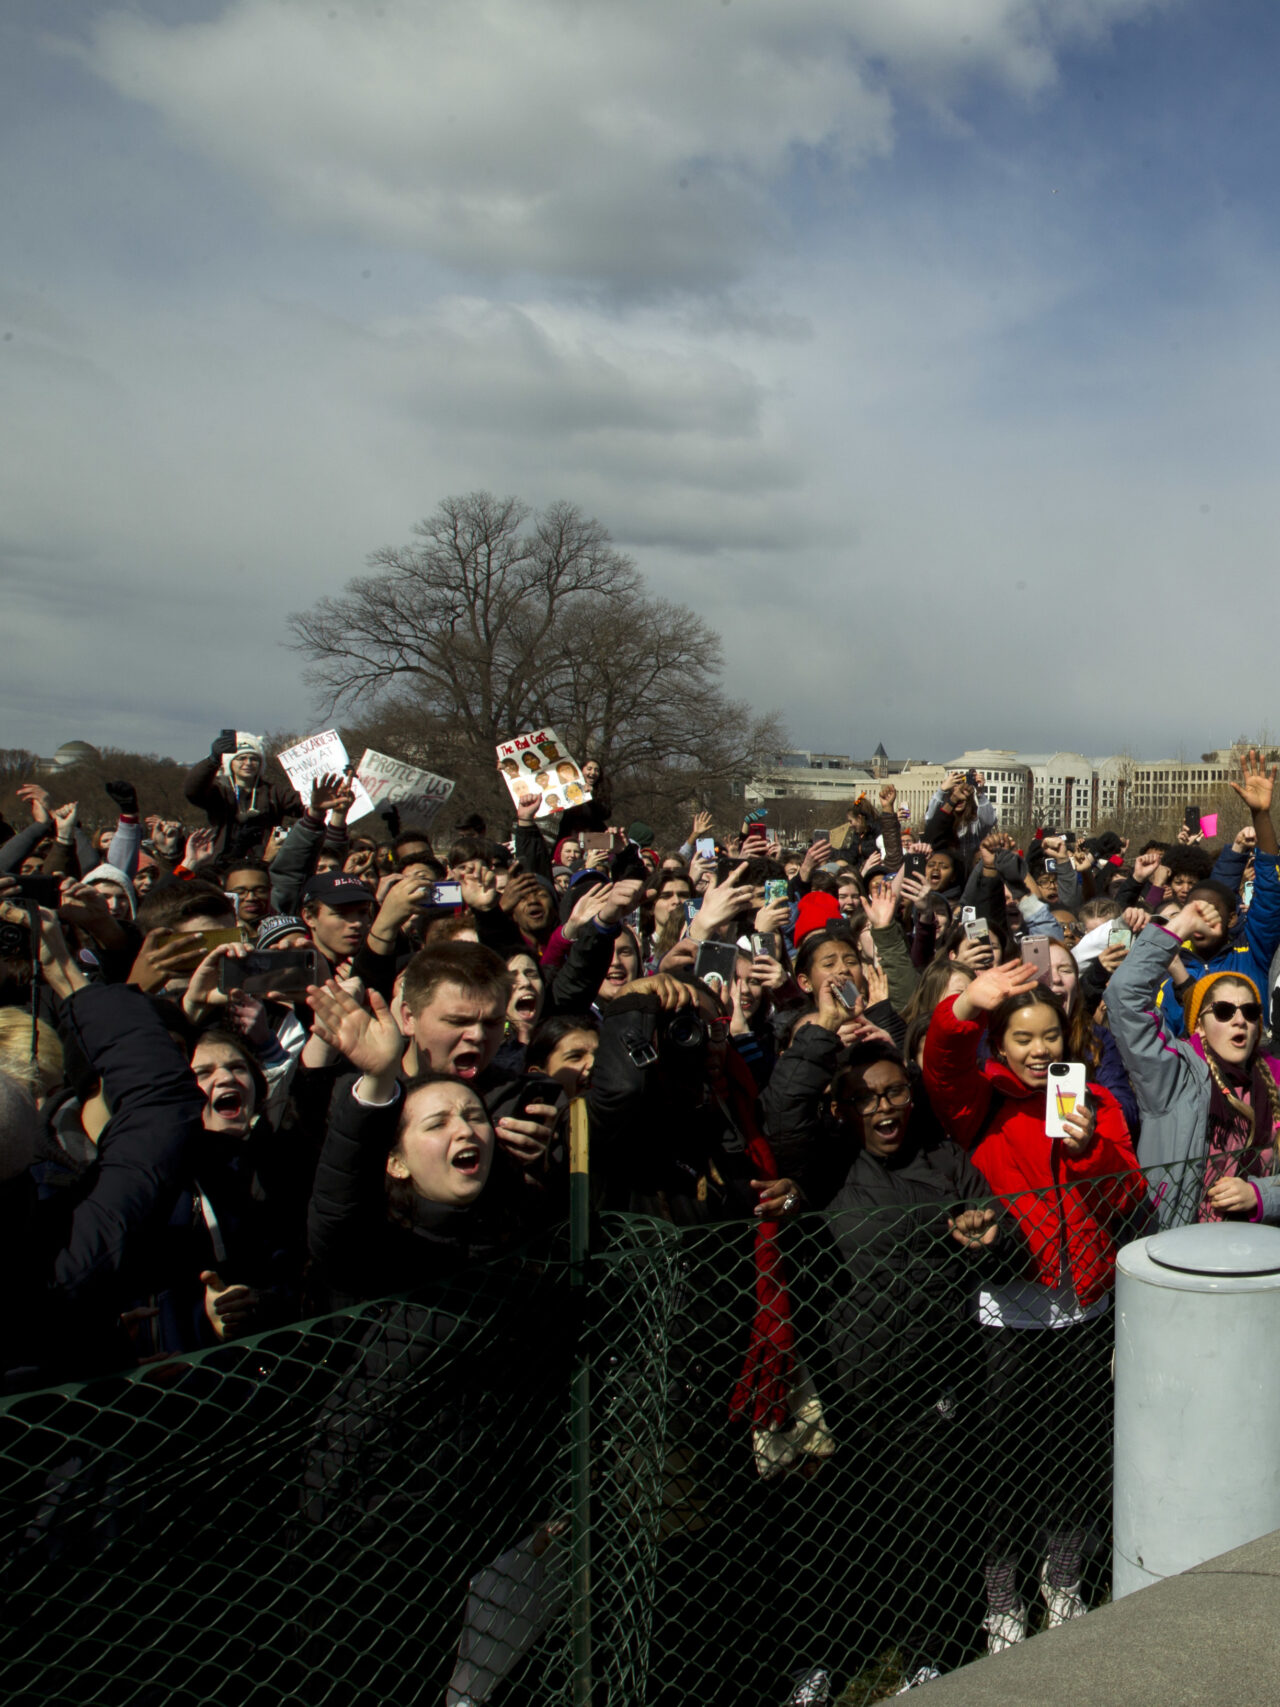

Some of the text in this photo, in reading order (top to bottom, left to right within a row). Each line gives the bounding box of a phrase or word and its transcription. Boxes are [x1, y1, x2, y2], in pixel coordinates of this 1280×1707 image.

[281, 732, 339, 764] THE SCARIEST
[285, 747, 333, 778] THING AT
[500, 745, 515, 756] The
[302, 763, 337, 785] SCHOOL
[367, 753, 452, 796] PROTECT US
